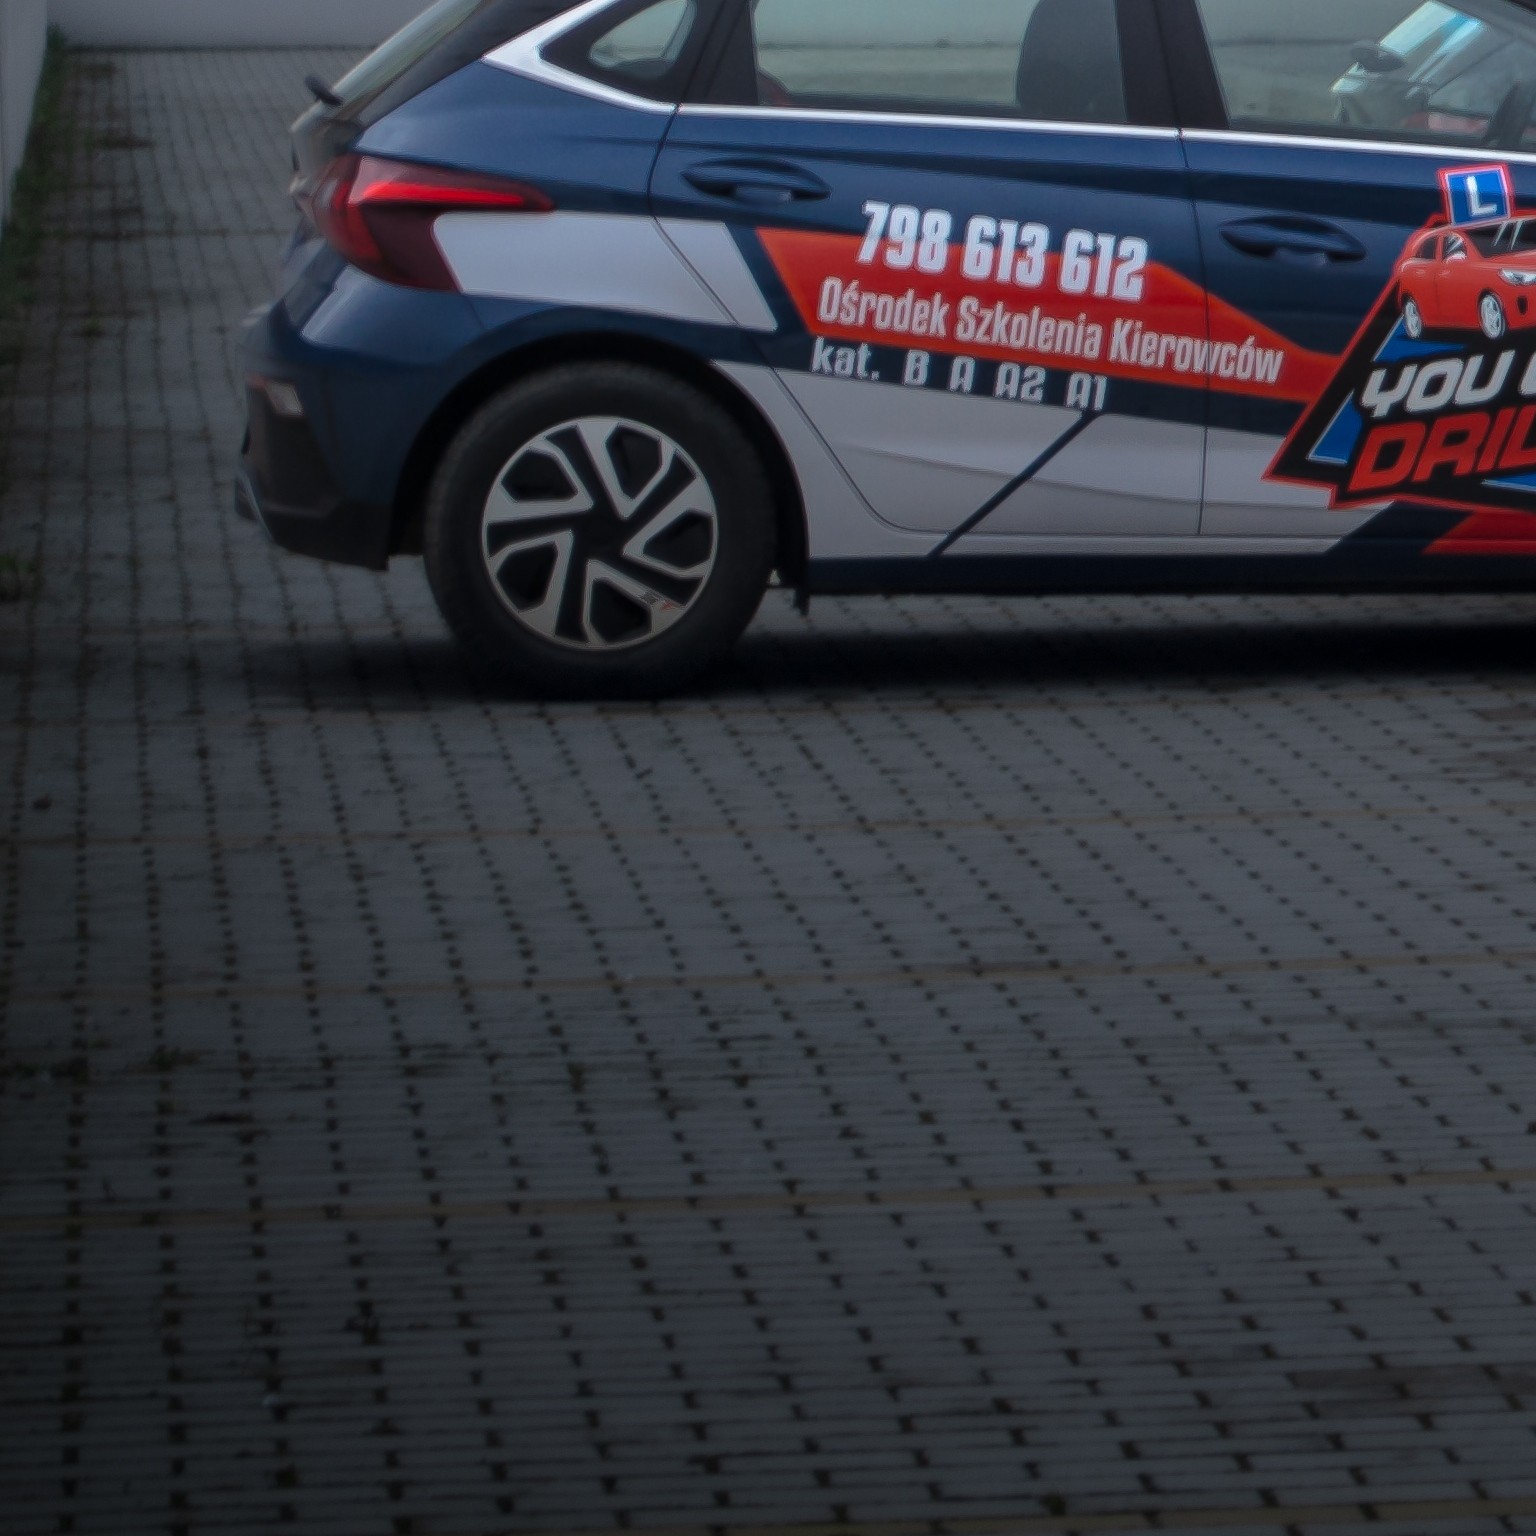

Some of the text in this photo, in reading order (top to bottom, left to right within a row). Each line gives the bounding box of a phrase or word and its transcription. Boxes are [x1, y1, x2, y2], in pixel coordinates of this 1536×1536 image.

[1467, 175, 1498, 216] L
[855, 200, 1149, 302] 798 613 612
[816, 275, 1285, 385] Ośrodek Szkolenia Kierowców
[810, 336, 1109, 410] kat. B A A2 A1
[1360, 349, 1516, 417] YOU
